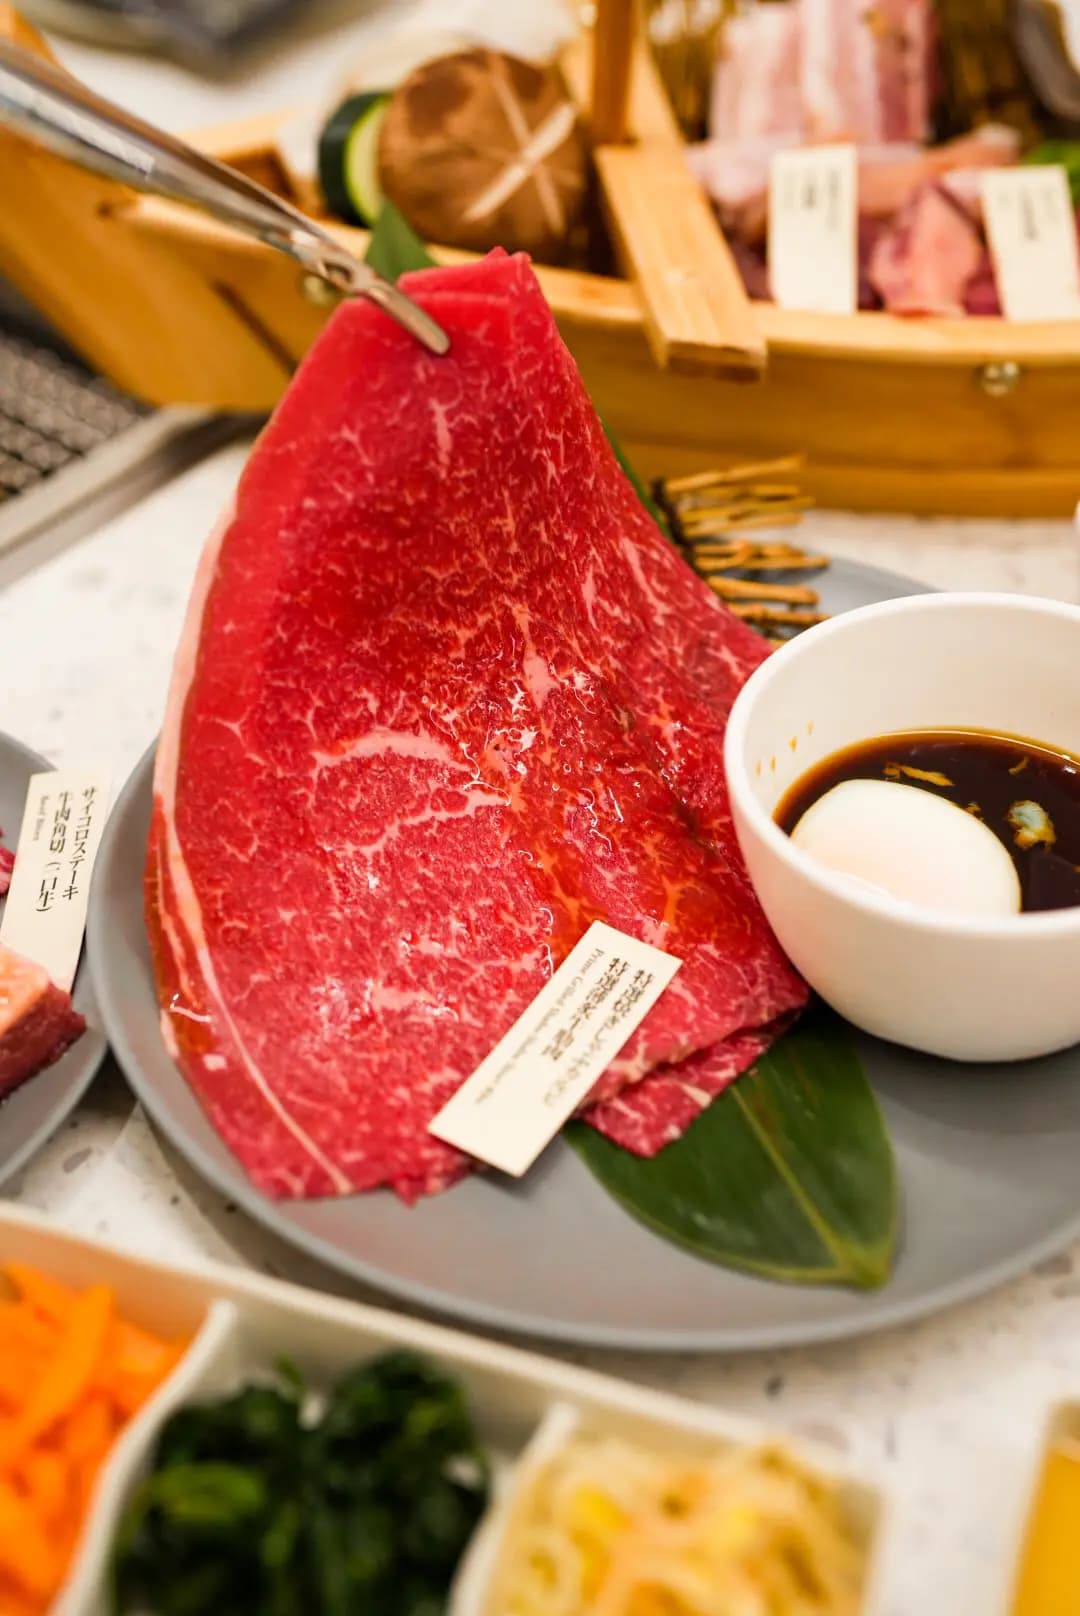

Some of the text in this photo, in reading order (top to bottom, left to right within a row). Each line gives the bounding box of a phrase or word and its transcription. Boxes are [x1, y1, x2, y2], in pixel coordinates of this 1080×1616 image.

[62, 787, 96, 900] サイコロステーキ
[580, 948, 604, 974] Prime
